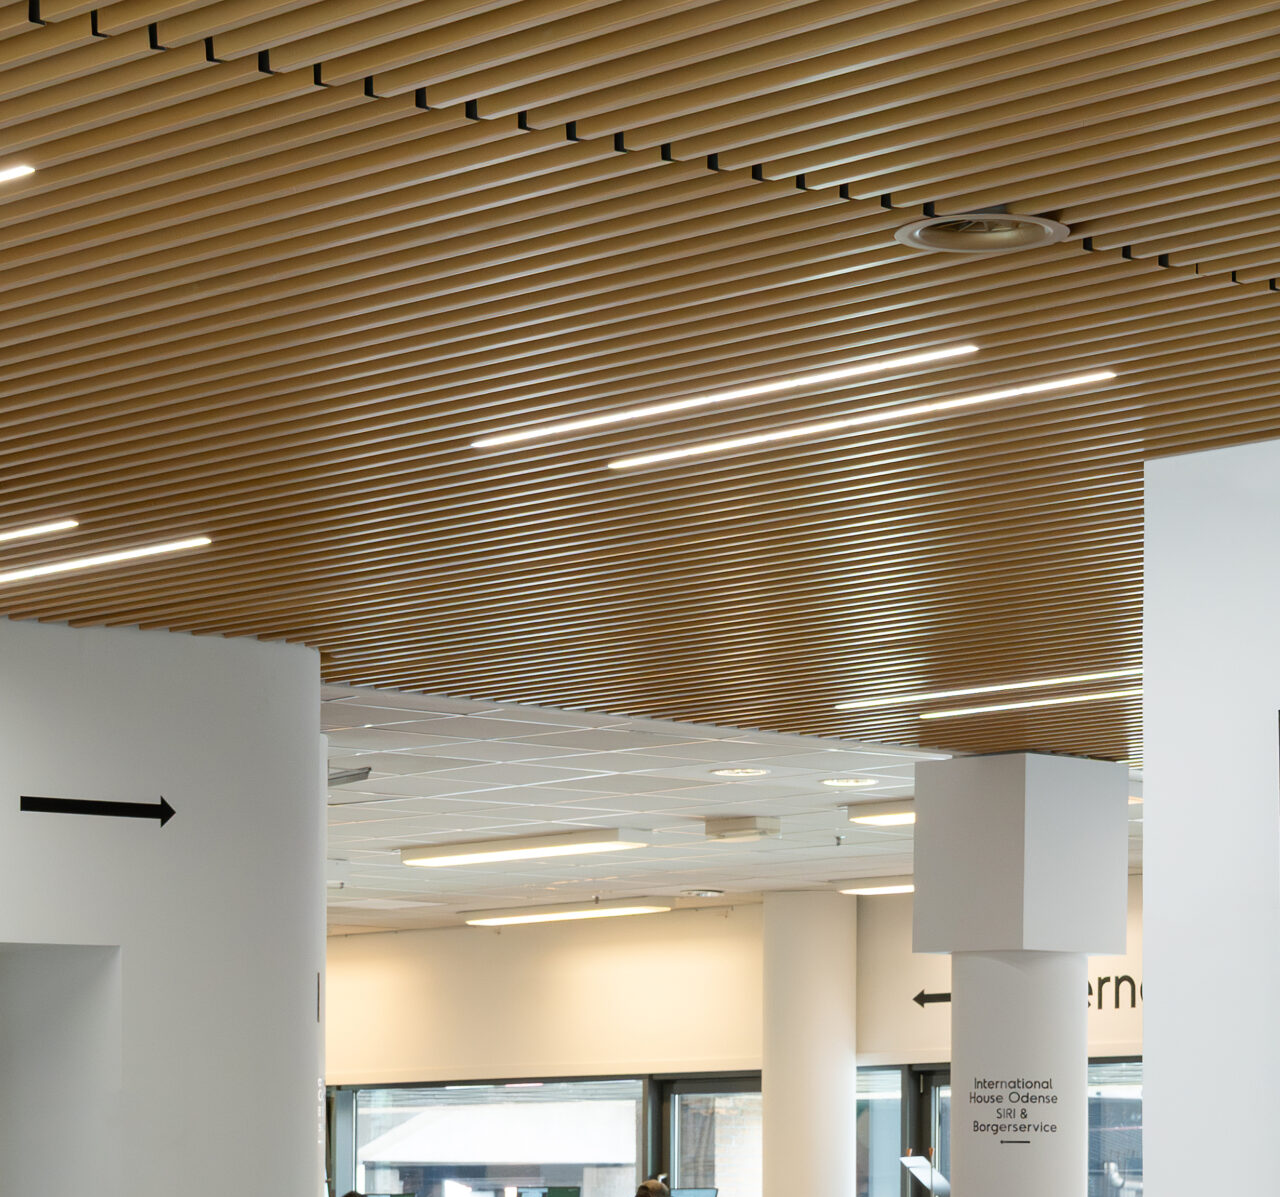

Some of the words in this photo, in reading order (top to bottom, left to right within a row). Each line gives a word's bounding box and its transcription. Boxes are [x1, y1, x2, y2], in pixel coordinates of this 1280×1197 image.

[1088, 975, 1143, 1010] rn
[974, 1078, 1053, 1090] International
[969, 1092, 1004, 1104] House
[1008, 1091, 1058, 1104] Odense
[996, 1108, 1016, 1119] SIRI
[1020, 1108, 1028, 1119] &
[973, 1120, 1057, 1135] Borgerservice
